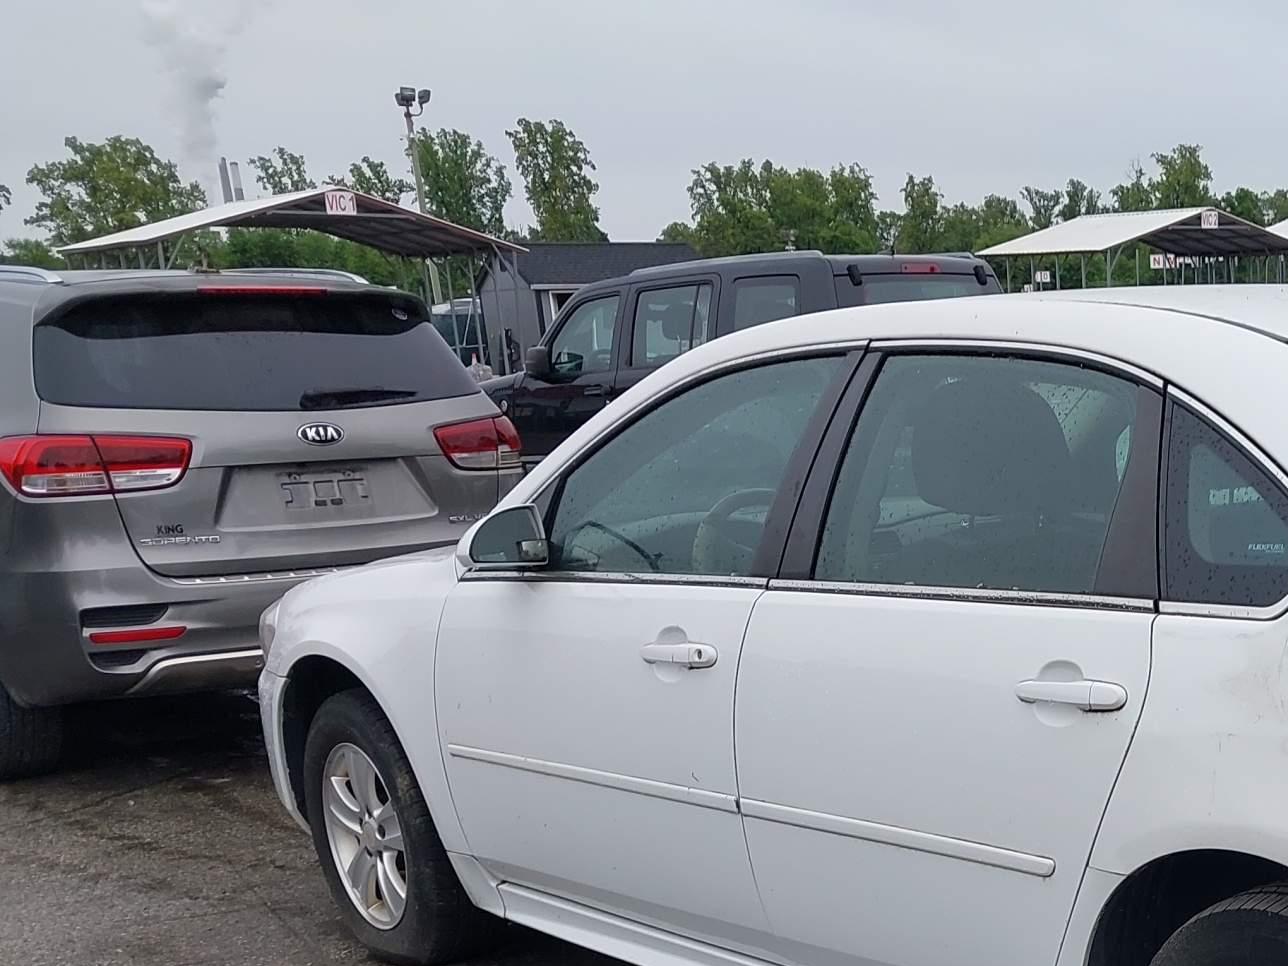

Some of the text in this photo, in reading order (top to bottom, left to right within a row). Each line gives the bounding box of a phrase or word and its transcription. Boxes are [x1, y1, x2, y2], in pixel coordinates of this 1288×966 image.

[326, 194, 356, 212] VIC 1
[305, 426, 339, 441] KIA
[156, 523, 184, 535] KING
[140, 535, 221, 546] SORENTO
